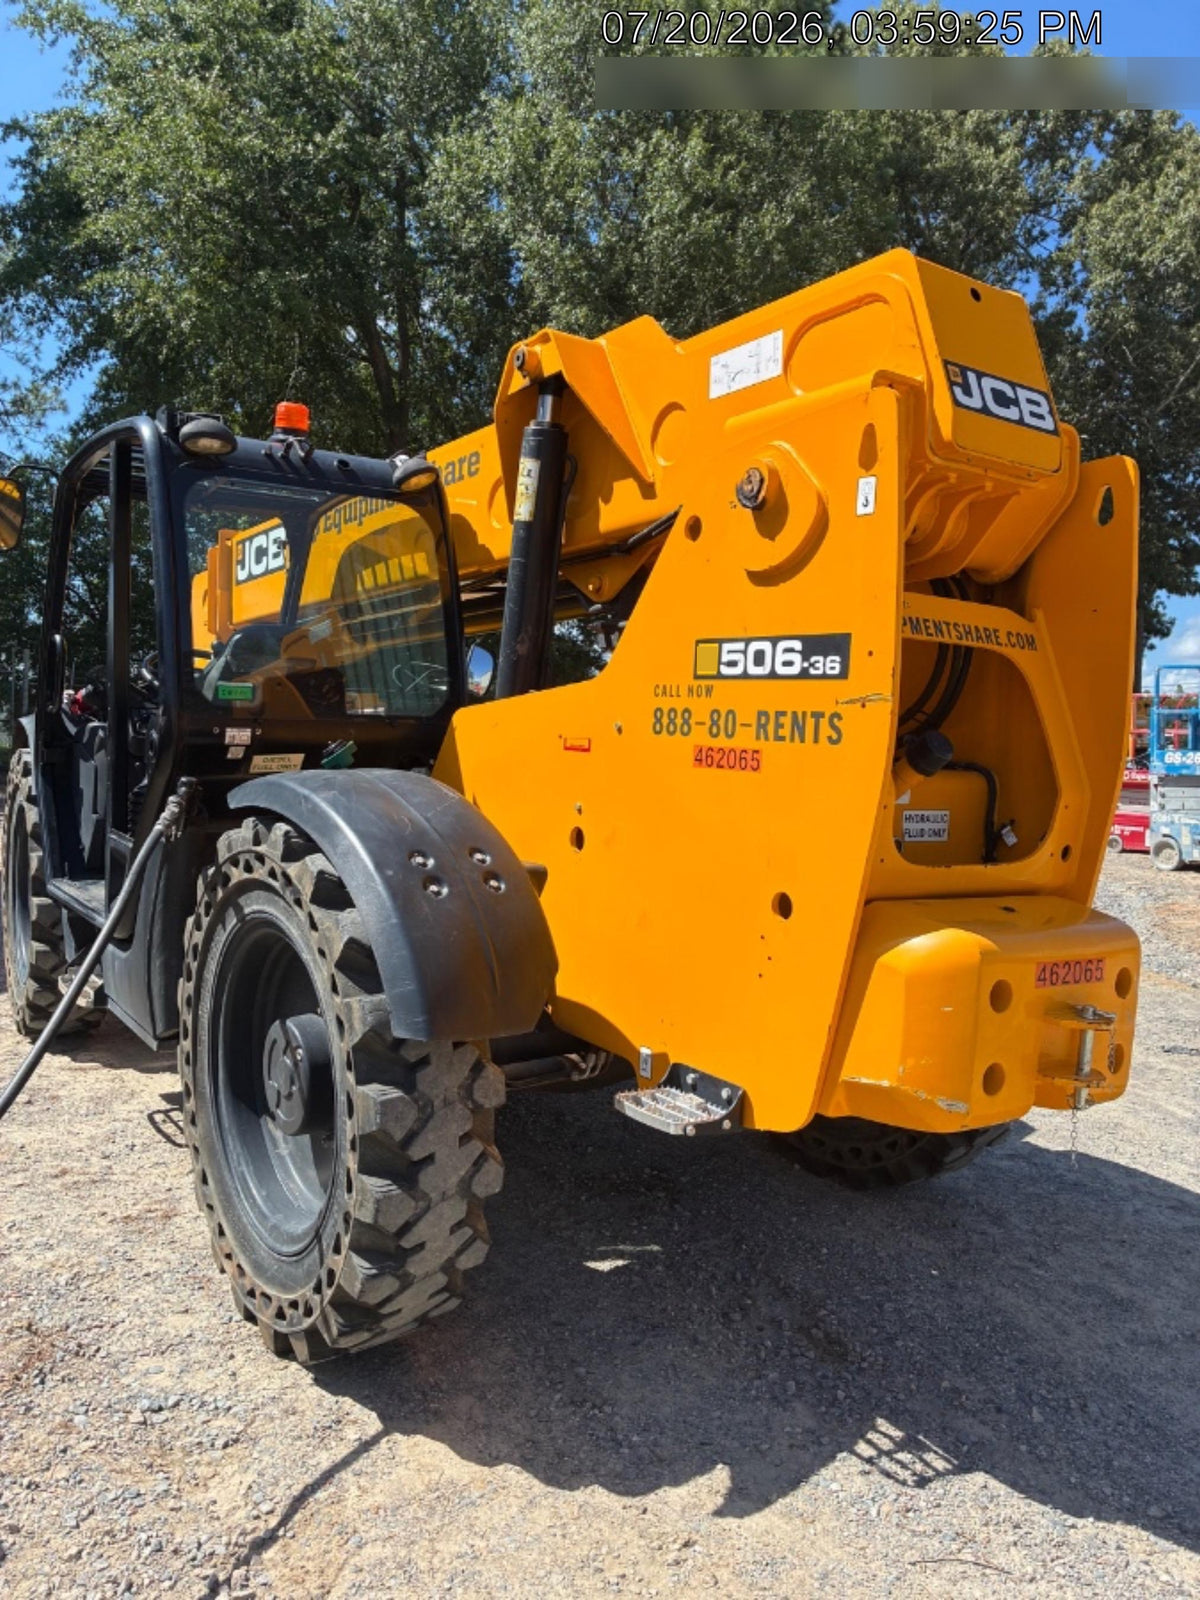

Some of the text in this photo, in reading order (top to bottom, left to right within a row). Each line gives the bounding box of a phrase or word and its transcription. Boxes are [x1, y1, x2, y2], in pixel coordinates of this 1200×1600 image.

[951, 370, 1055, 433] JCB
[237, 527, 287, 580] JCB
[653, 684, 714, 699] CALL NOW
[652, 707, 844, 746] 888-80-RENTS
[694, 746, 761, 772] 462065
[904, 813, 949, 824] HYDRAULIC
[1037, 959, 1105, 987] 462065
